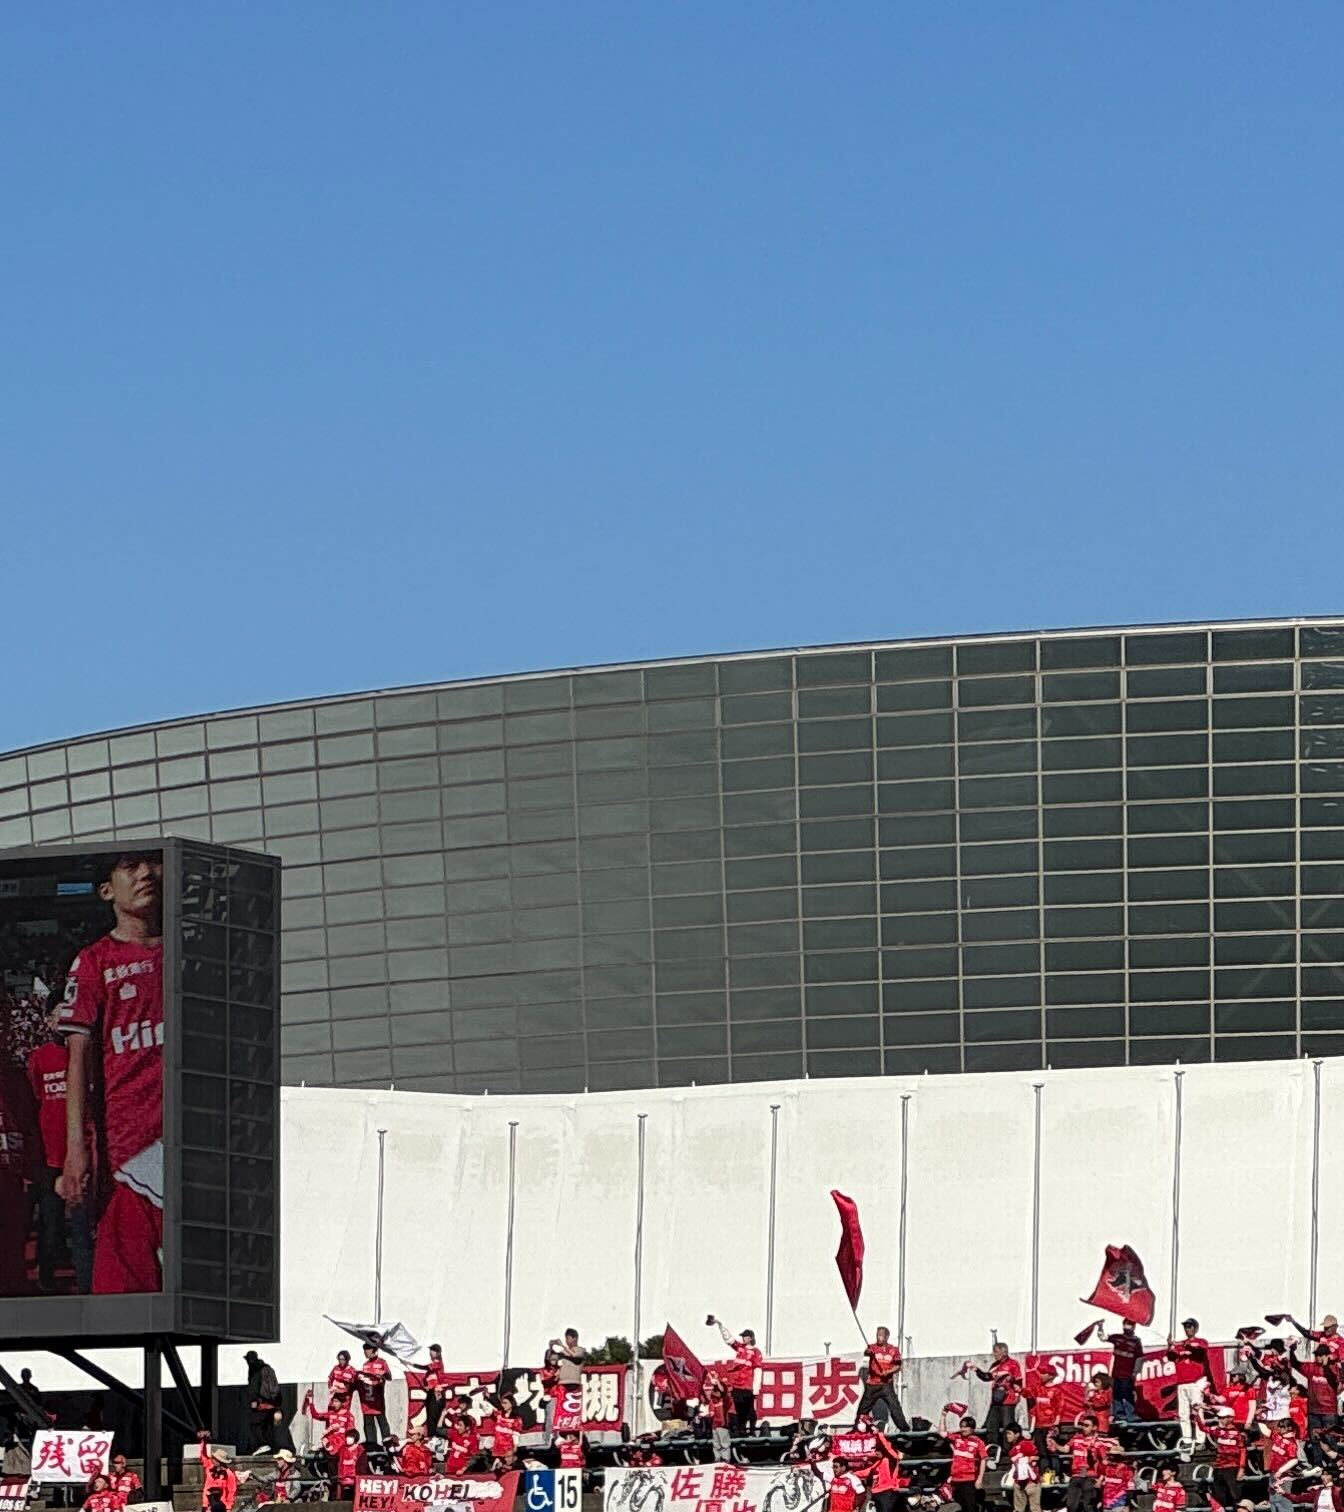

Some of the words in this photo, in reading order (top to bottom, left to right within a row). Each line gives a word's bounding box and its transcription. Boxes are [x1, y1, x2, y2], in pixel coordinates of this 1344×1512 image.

[359, 1479, 399, 1495] HEY!
[403, 1483, 470, 1501] KOHEI
[557, 1473, 579, 1508] 15
[671, 1467, 747, 1501] 佐藤
[358, 1495, 395, 1510] HEY!
